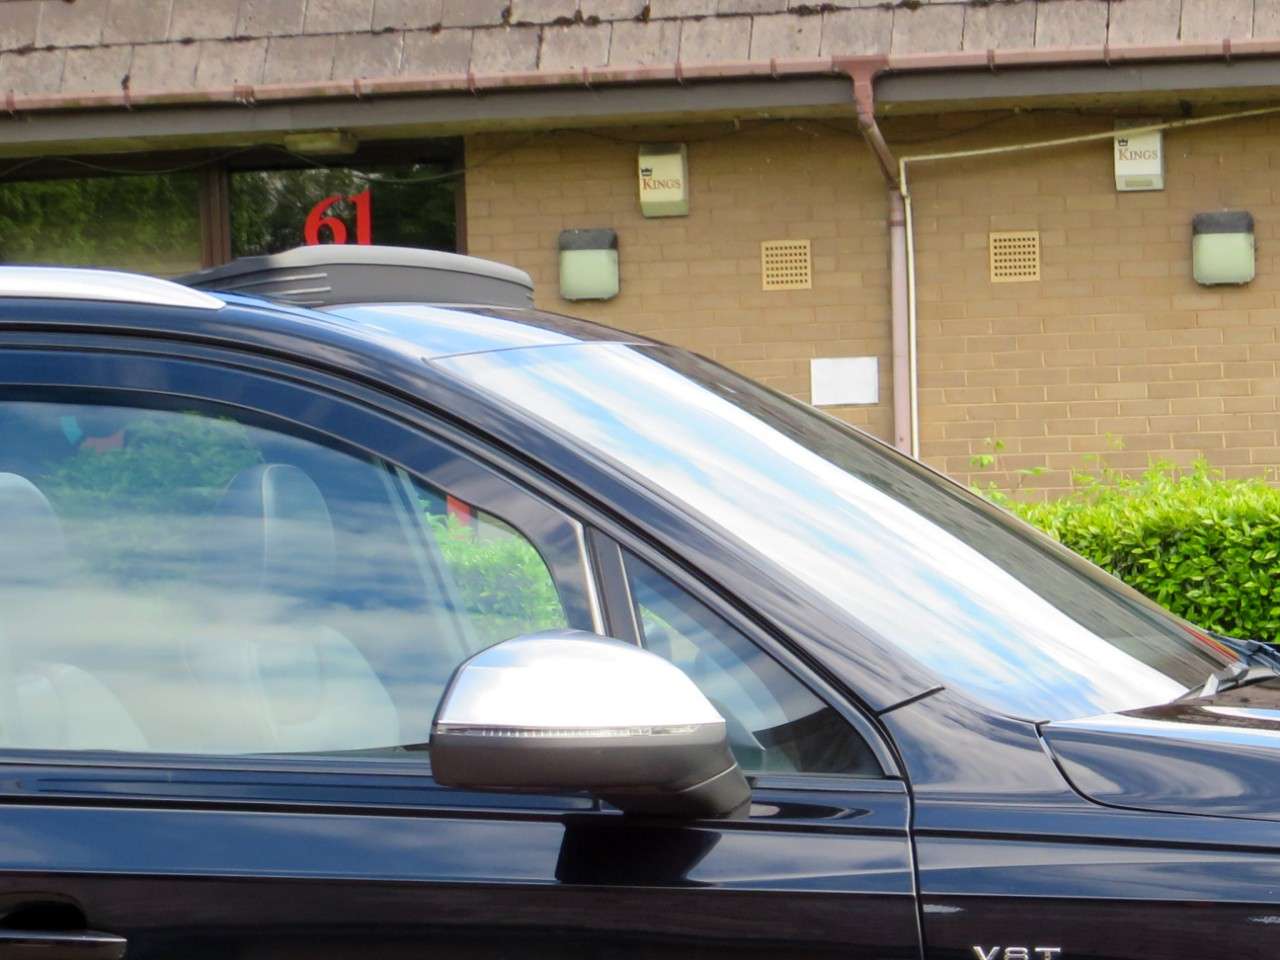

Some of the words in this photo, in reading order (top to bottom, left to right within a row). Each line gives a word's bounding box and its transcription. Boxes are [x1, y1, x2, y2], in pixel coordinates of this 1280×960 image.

[1119, 148, 1158, 161] KINGS
[642, 178, 681, 190] KINGS
[304, 189, 371, 246] 61
